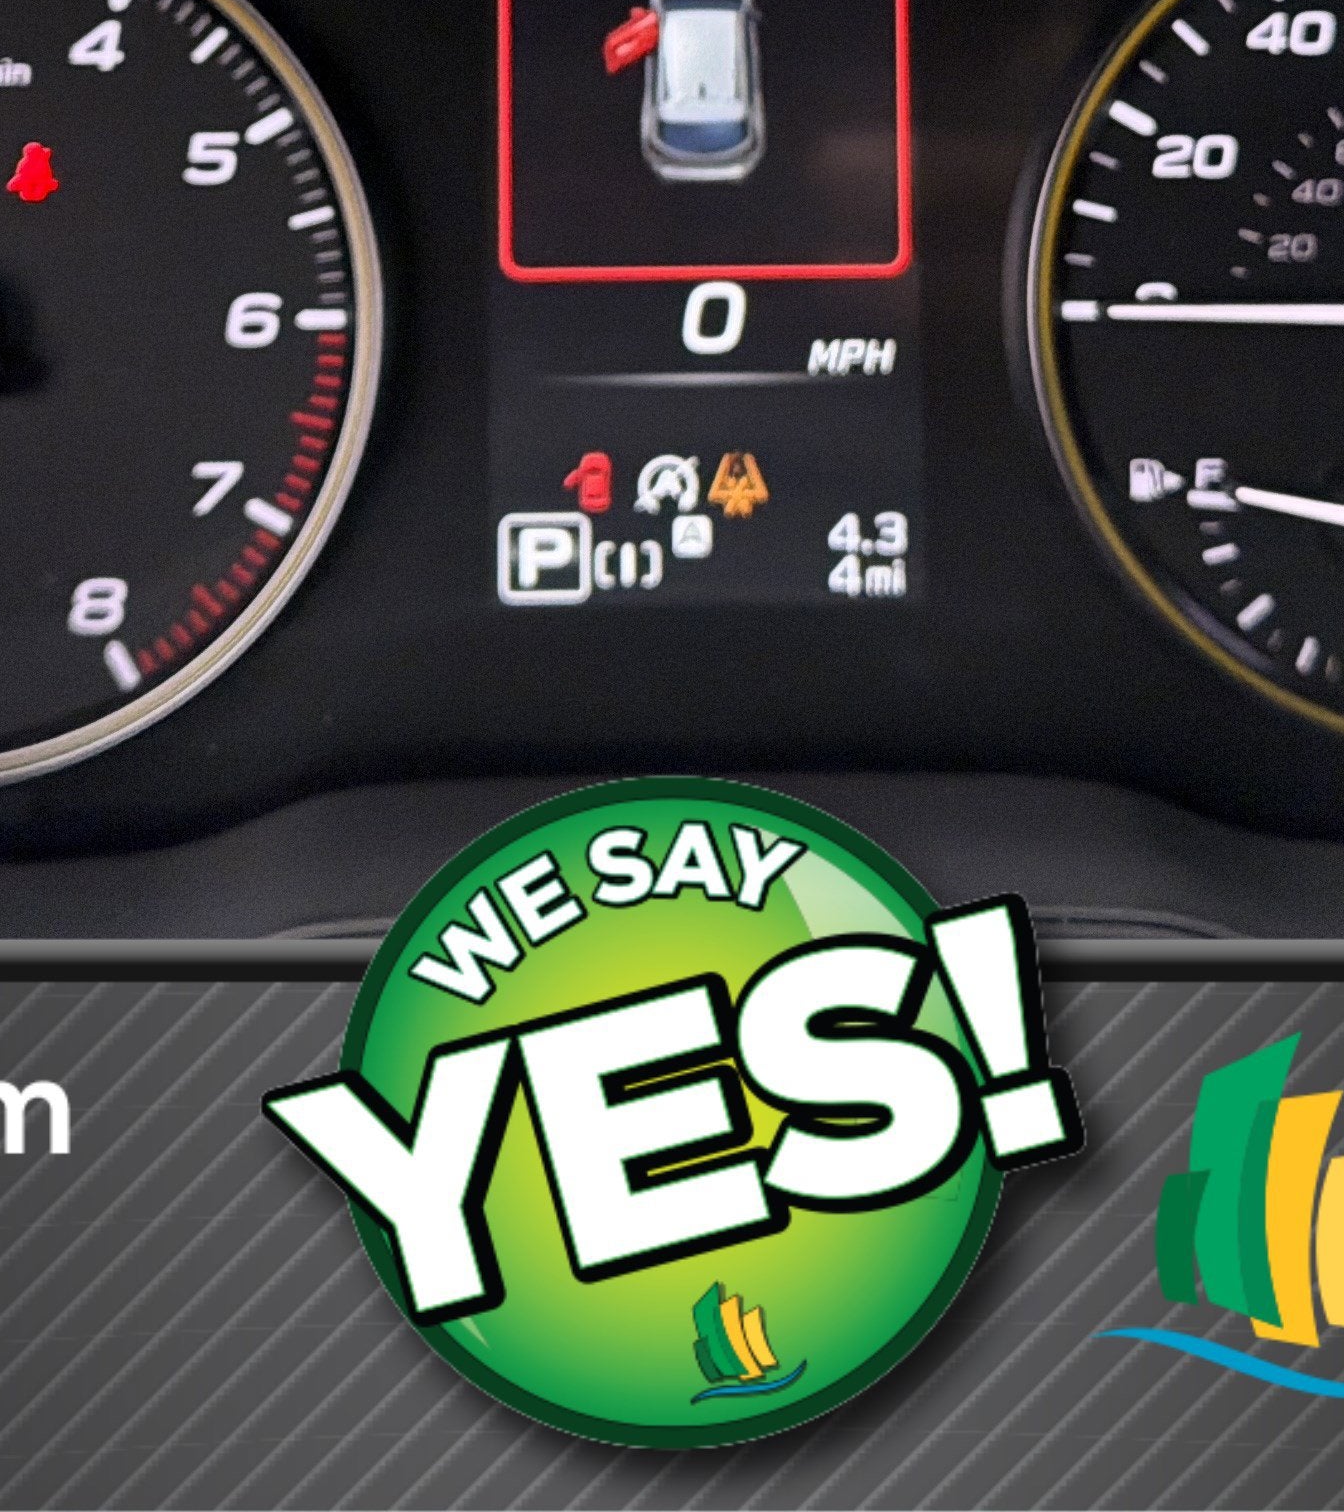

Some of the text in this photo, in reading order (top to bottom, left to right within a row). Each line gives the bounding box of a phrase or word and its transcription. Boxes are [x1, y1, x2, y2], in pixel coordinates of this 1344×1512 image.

[68, 19, 125, 72] 4
[1245, 10, 1337, 56] 40
[183, 131, 240, 186] 5
[1151, 133, 1239, 179] 20
[1291, 178, 1344, 205] 40
[1267, 233, 1318, 262] 20
[225, 292, 283, 349] 6
[682, 282, 746, 355] 0
[807, 338, 897, 376] MPH
[192, 460, 246, 517] 7
[1194, 458, 1226, 487] F
[827, 511, 908, 556] 4.3
[518, 527, 574, 589] P
[827, 555, 907, 597] 4mi
[68, 577, 128, 636] 8
